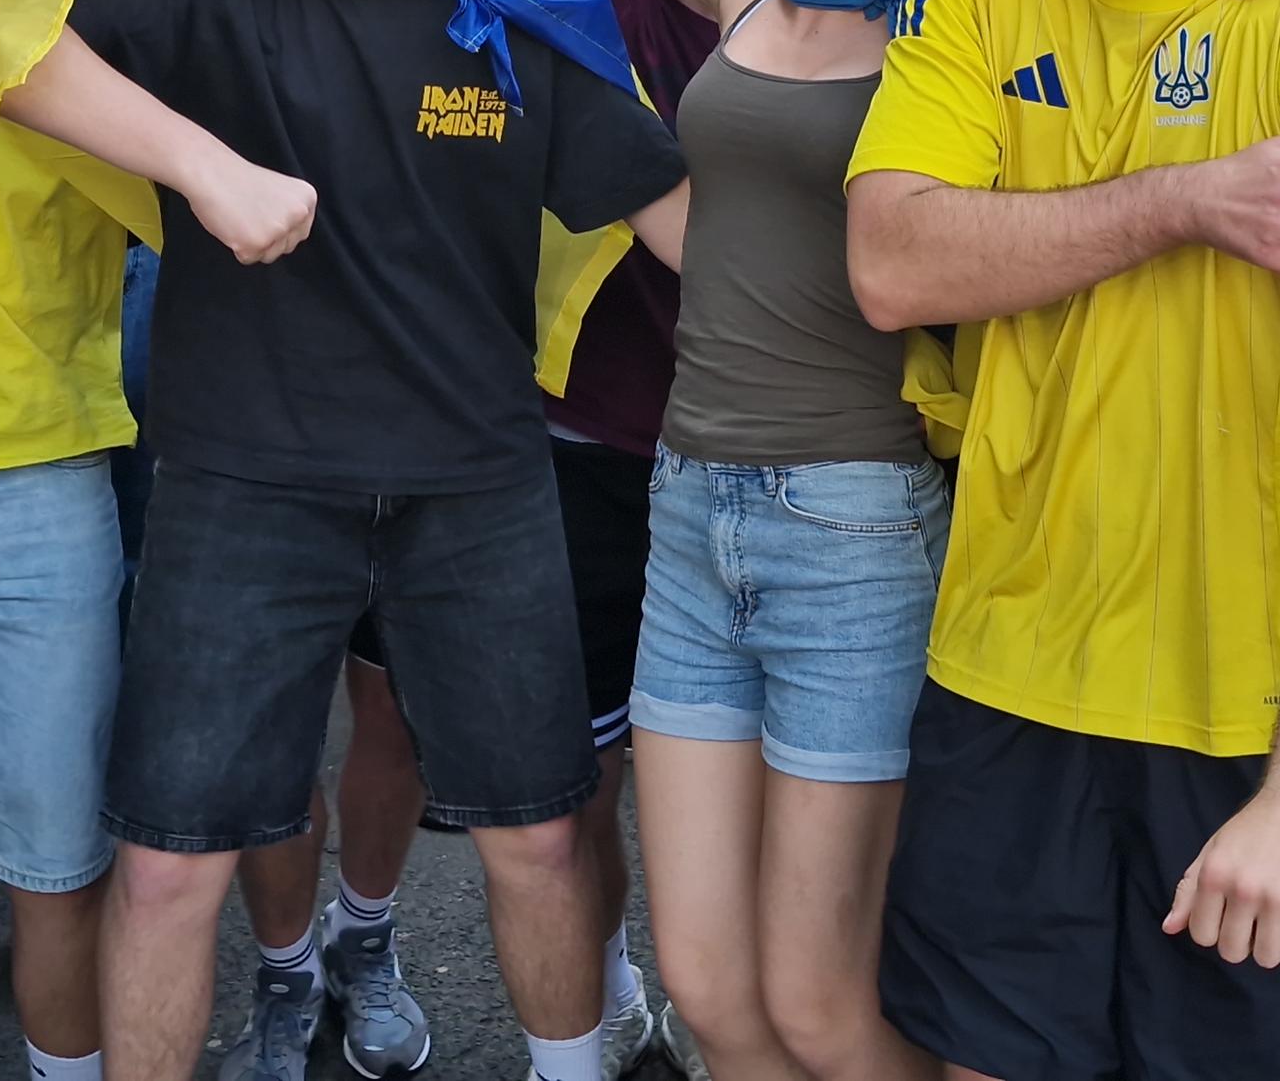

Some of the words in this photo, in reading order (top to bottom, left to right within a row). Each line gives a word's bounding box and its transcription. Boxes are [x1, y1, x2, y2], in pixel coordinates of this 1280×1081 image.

[422, 85, 480, 118] IRON
[479, 100, 506, 111] 1975
[416, 111, 505, 143] MAIDEN
[1156, 114, 1207, 127] UKRAINE
